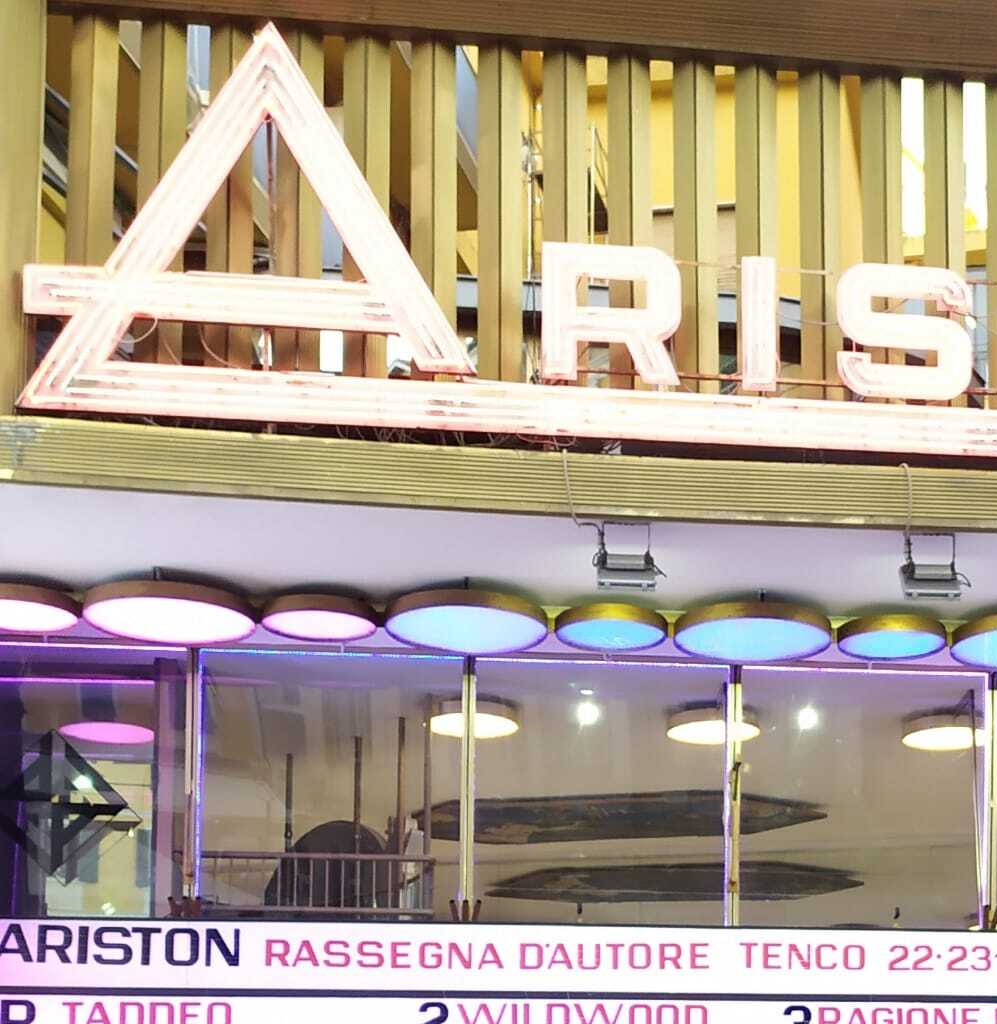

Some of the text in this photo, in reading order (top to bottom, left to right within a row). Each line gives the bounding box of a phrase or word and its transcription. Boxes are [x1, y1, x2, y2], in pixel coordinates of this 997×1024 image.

[0, 923, 241, 967] ARISTON
[264, 938, 504, 970] RASSEGNA
[740, 942, 866, 970] TENCO
